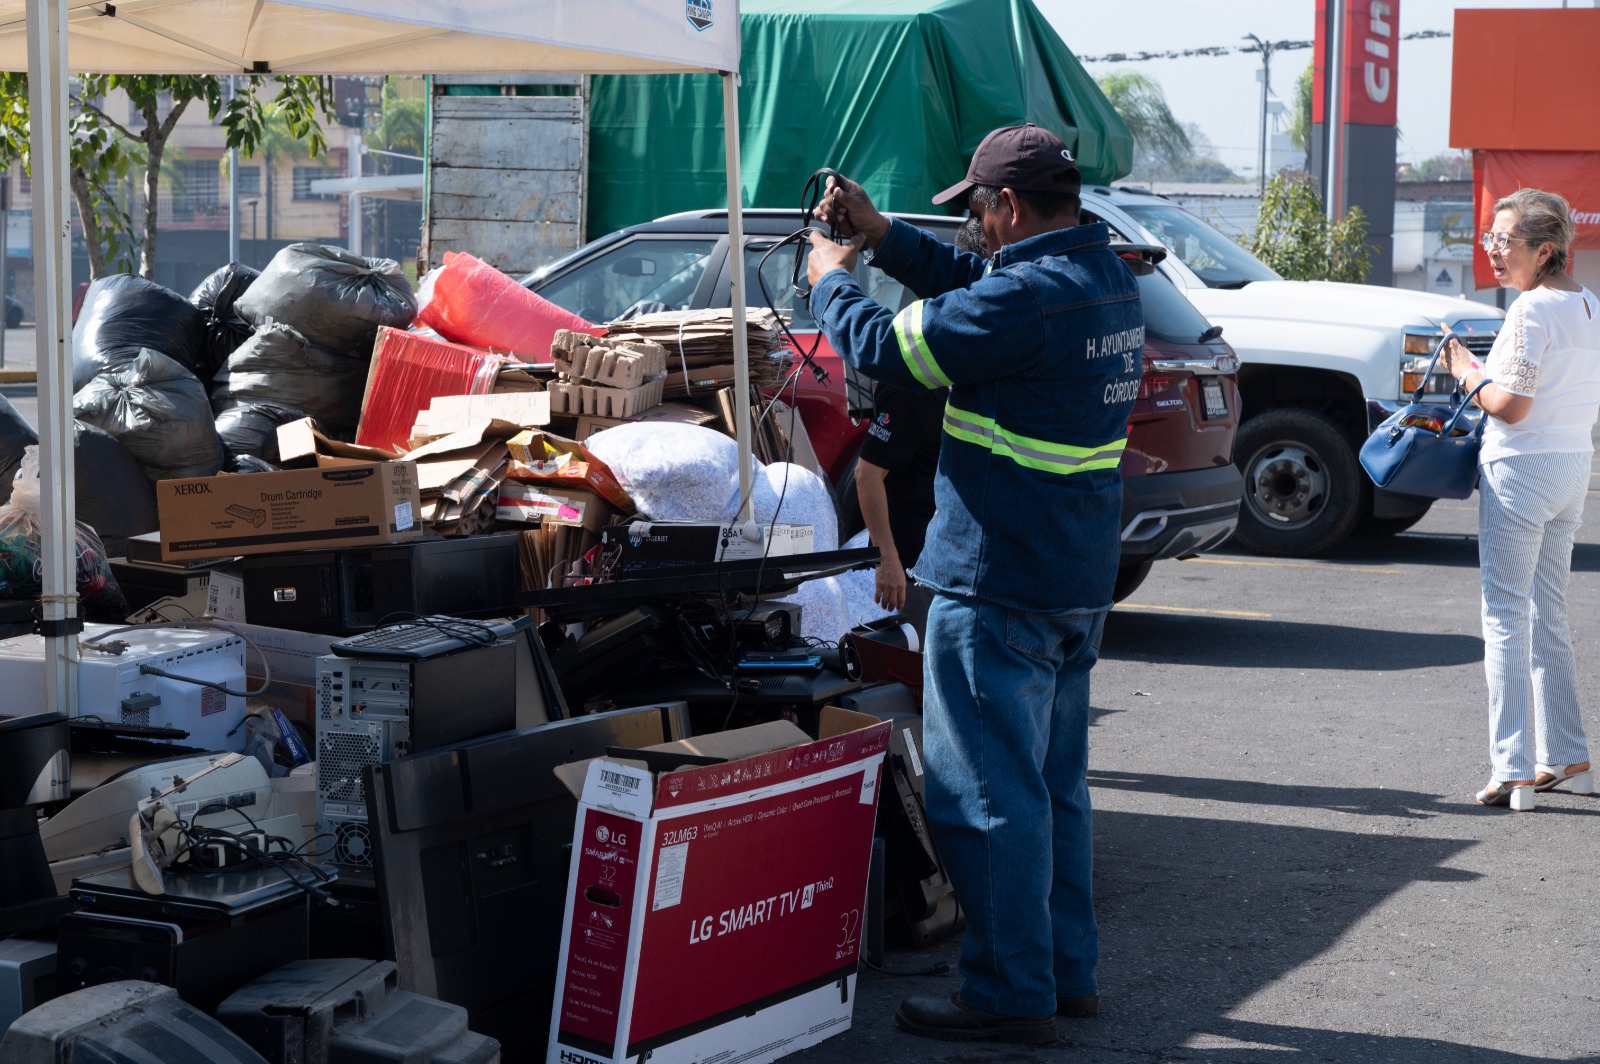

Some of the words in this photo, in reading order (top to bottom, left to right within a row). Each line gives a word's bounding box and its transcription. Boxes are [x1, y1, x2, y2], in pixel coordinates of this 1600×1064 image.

[1086, 338, 1099, 359] H.
[1122, 352, 1134, 373] DE
[1103, 378, 1141, 404] CÓRDOB
[1156, 399, 1183, 407] SELTOS
[260, 491, 284, 503] Drum
[285, 488, 323, 501] Cartridge
[757, 809, 776, 821] Dynamic
[776, 806, 788, 816] Color
[611, 831, 627, 846] LG
[661, 825, 698, 846] 32LM63
[599, 864, 617, 883] 32
[689, 915, 713, 945] LG
[717, 896, 777, 937] SMART
[779, 888, 800, 917] TV
[801, 884, 815, 909] AI
[815, 876, 834, 894] ThinQ
[836, 908, 859, 948] 32
[592, 1004, 614, 1016] Processor
[559, 1049, 607, 1064] HDM
